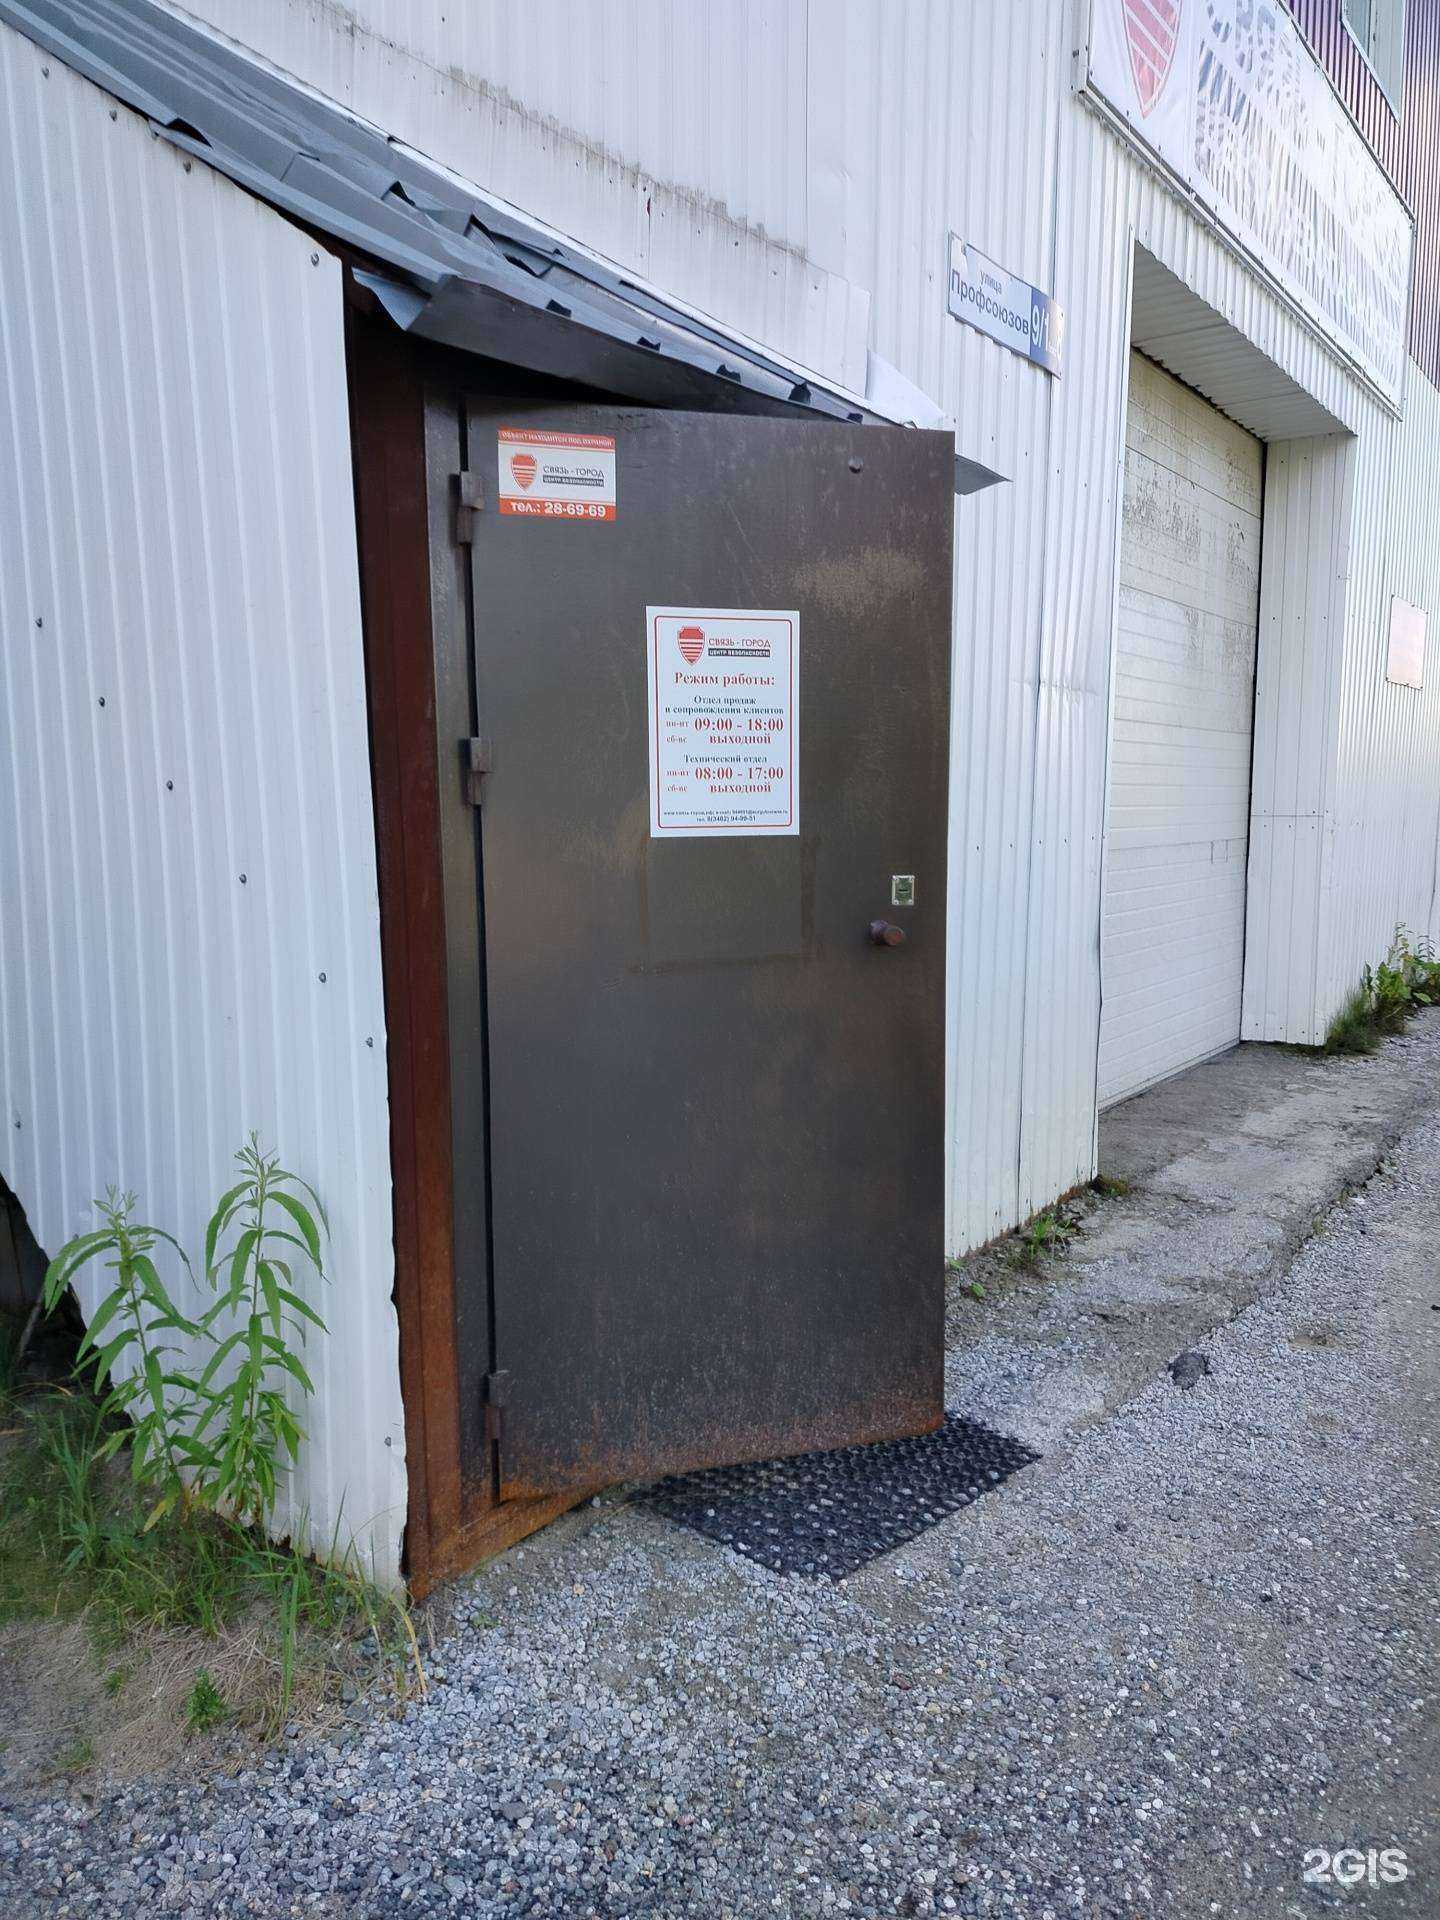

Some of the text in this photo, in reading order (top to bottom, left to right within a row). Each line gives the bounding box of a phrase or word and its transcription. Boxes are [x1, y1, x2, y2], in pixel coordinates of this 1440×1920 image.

[980, 270, 1002, 295] улица
[951, 268, 1029, 336] Профсоюзов
[543, 465, 569, 475] СВЯЗЬ
[576, 467, 605, 478] ГОРОД
[544, 502, 606, 517] 28-69-69
[708, 638, 735, 647] СВЯЗЬ
[741, 639, 771, 648] ГОРОД
[674, 672, 776, 687] Режим работы:
[693, 695, 757, 706] Отдел продаж
[673, 707, 741, 716] сопровождения
[694, 718, 733, 731] 09:00
[747, 718, 784, 731] 18:00
[709, 733, 772, 744] выходной
[684, 754, 768, 764] Технический отдел
[695, 767, 733, 780] 08:00
[748, 767, 784, 779] 17:00
[710, 782, 772, 793] выходной
